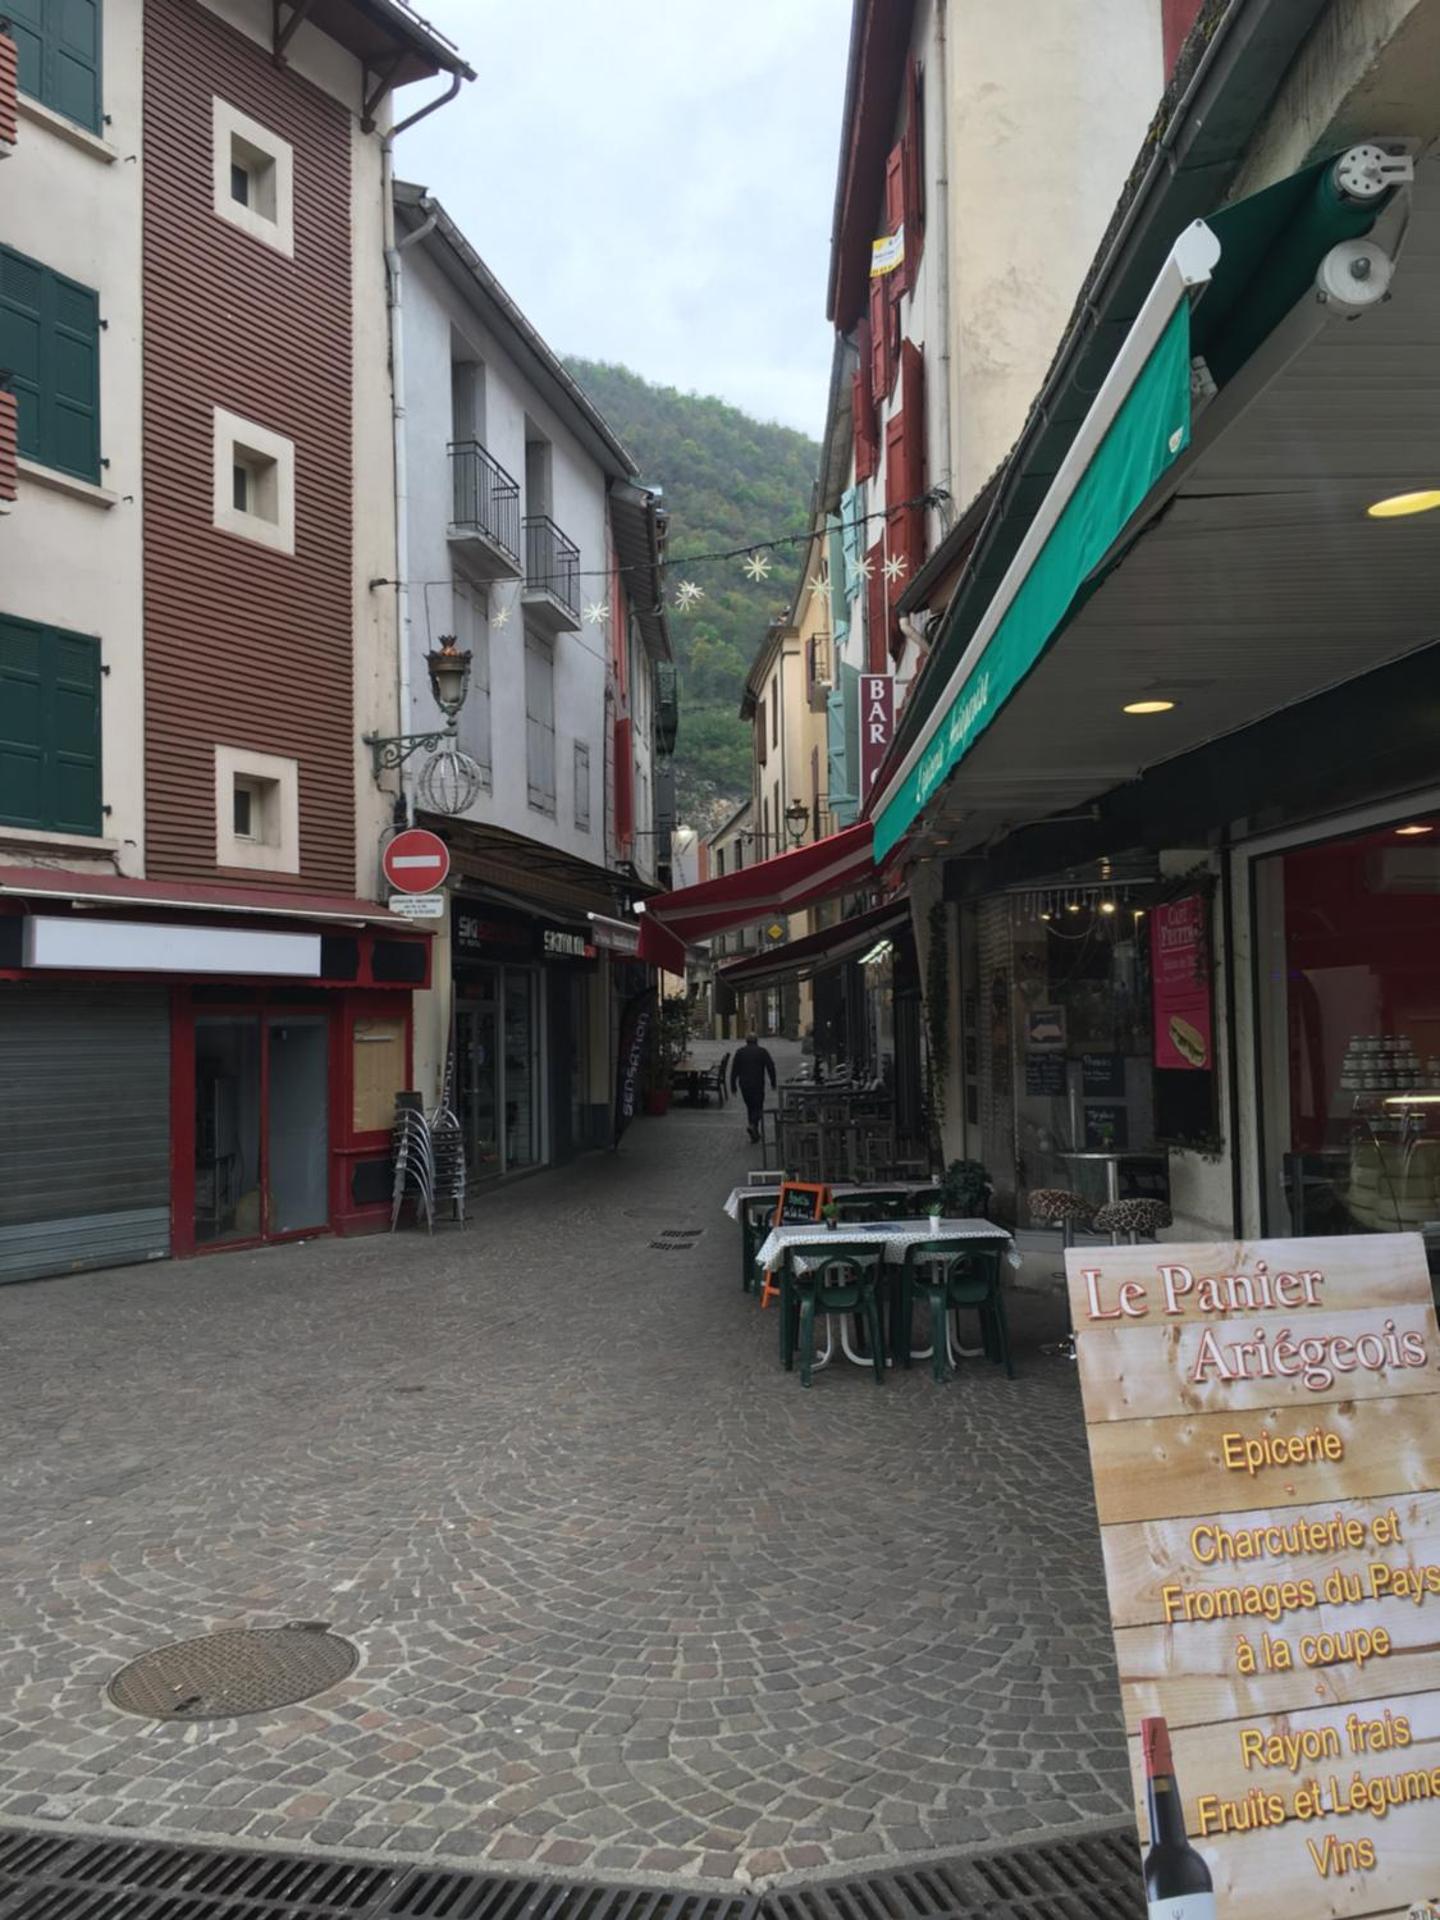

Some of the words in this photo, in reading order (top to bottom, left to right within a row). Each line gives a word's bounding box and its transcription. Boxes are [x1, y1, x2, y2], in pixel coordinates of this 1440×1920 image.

[868, 679, 886, 744] BAR
[1082, 1269, 1146, 1320] Le
[1158, 1263, 1323, 1313] Panier
[1193, 1320, 1427, 1392] Ariégeois
[1222, 1427, 1342, 1473] Epicerie
[1190, 1513, 1364, 1563] Charcuterie
[1371, 1509, 1401, 1543] et
[1161, 1576, 1316, 1625] Fromages
[1324, 1568, 1363, 1605] du
[1235, 1636, 1255, 1673] à
[1263, 1630, 1292, 1671] la
[1299, 1625, 1389, 1664] coupe
[1240, 1725, 1340, 1771] Rayon
[1345, 1710, 1411, 1754] frais
[1197, 1786, 1284, 1835] Fruits
[1292, 1780, 1324, 1821] et
[1307, 1833, 1375, 1875] Vins
